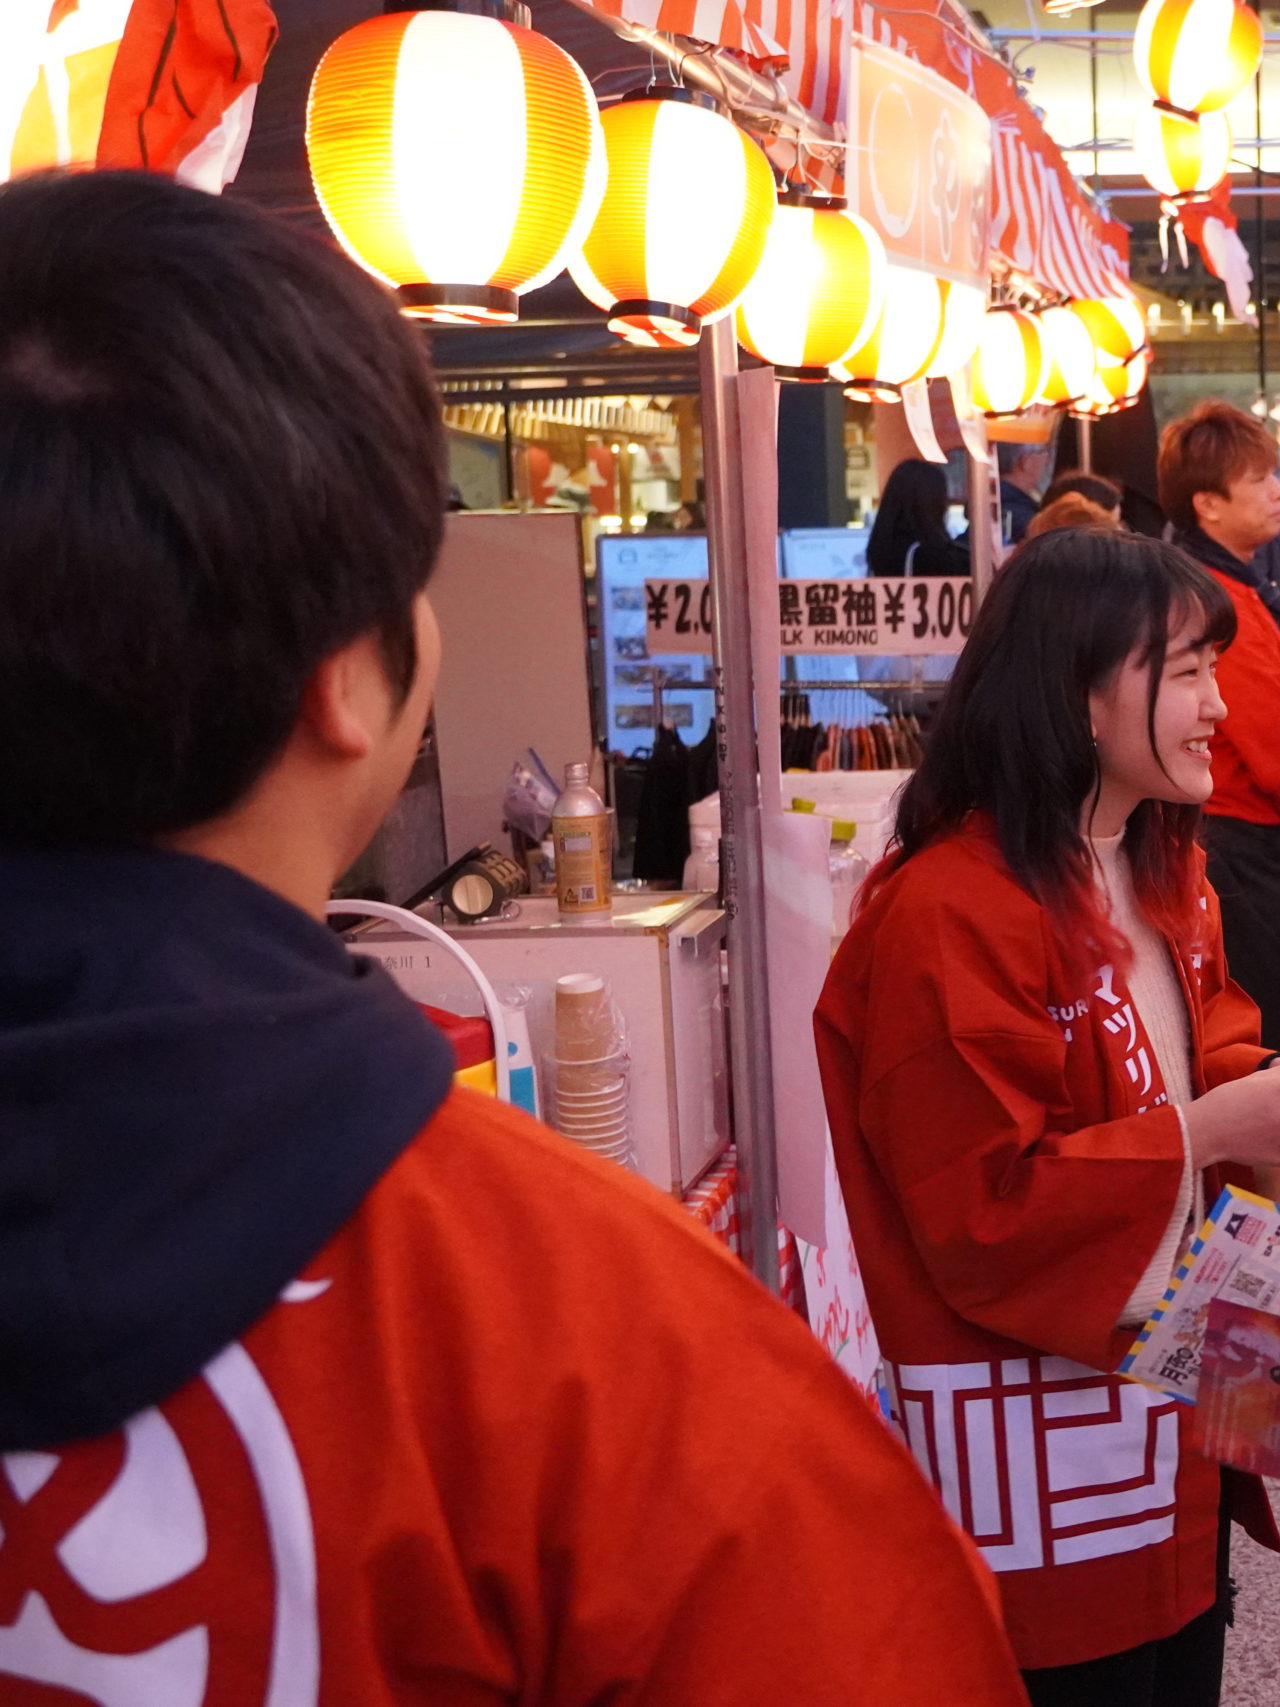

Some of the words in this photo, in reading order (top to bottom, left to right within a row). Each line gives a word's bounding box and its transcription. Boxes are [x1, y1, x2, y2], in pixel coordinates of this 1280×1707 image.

[646, 583, 713, 635] ¥2,0
[883, 582, 972, 639] ¥3,00
[779, 629, 802, 646] ILK
[814, 629, 878, 646] KIMONO
[383, 955, 413, 970] 奈川
[1095, 963, 1168, 1115] マツリ
